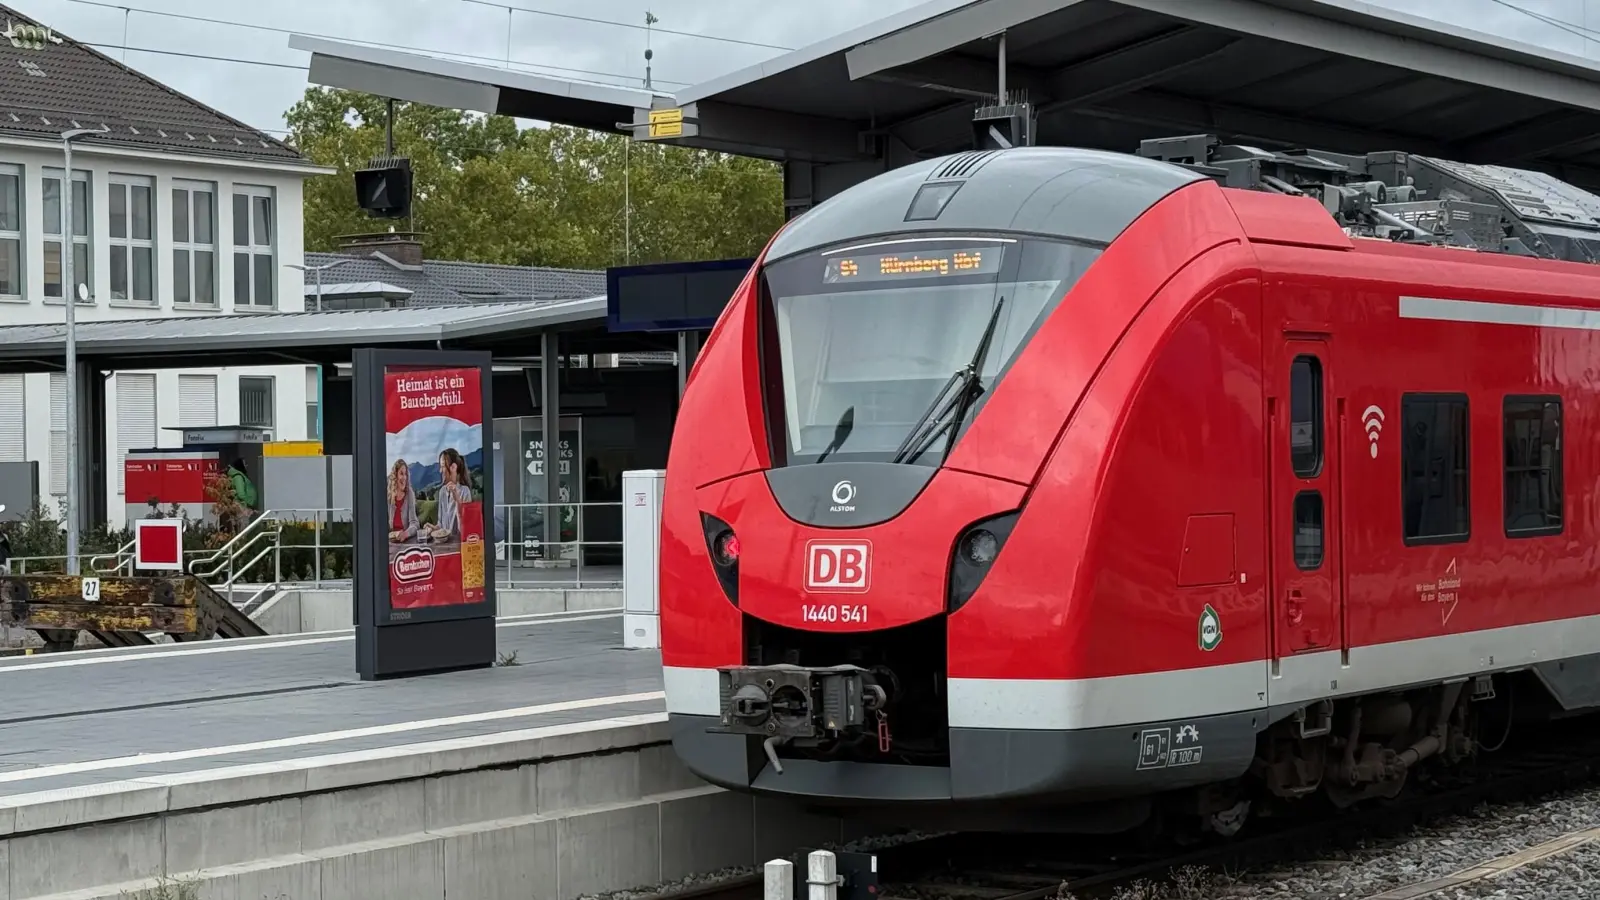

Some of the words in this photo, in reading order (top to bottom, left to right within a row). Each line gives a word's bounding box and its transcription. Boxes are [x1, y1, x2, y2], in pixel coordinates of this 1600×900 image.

[880, 256, 948, 275] Nürnberg
[396, 377, 433, 393] Heimat
[435, 375, 449, 390] ist
[450, 374, 465, 388] ein
[400, 391, 465, 410] Bauchgefühl.
[529, 440, 569, 449] SNKS
[525, 450, 533, 458] &
[811, 547, 864, 585] DB
[85, 581, 97, 596] 27
[802, 604, 837, 622] 1440
[841, 605, 868, 623] 541
[1203, 625, 1216, 634] VGN
[1171, 752, 1177, 763] R
[1179, 750, 1193, 762] 100
[1193, 752, 1200, 761] m
